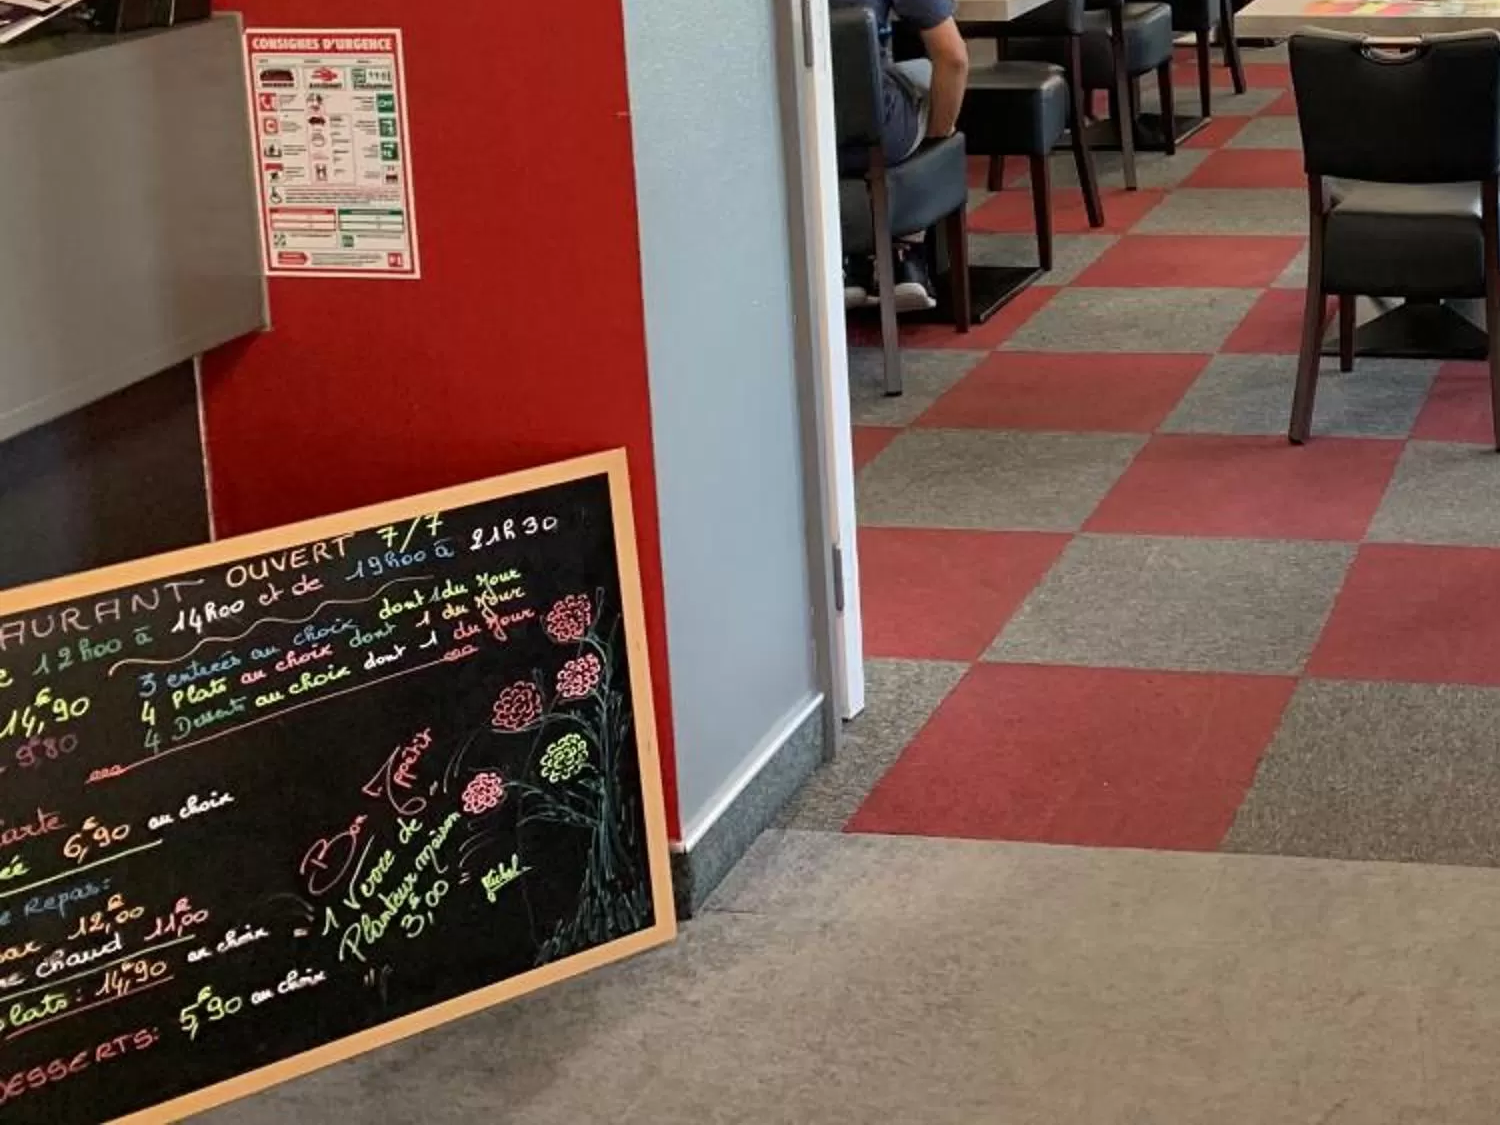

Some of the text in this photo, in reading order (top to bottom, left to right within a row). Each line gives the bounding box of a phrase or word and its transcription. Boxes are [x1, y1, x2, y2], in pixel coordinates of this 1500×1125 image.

[251, 37, 394, 51] CONSIGNES D'URGENCE
[225, 534, 356, 588] OUVERT
[376, 511, 444, 554] 7/7
[32, 637, 122, 676] 12h00
[171, 599, 245, 635] 14h00
[258, 583, 284, 606] et
[291, 573, 324, 596] de
[344, 550, 428, 582] 19h00
[468, 515, 559, 551] 21h30
[250, 645, 281, 661] au
[292, 617, 358, 647] choix
[377, 588, 426, 621] dont
[441, 579, 469, 598] du
[140, 699, 156, 726] 4
[239, 669, 268, 685] au
[274, 643, 334, 673] choix
[349, 622, 398, 649] dont
[441, 603, 470, 621] du
[254, 690, 285, 708] au
[288, 663, 352, 695] choix
[363, 644, 407, 671] dont
[453, 621, 482, 641] du
[0, 807, 66, 848] arte
[148, 815, 174, 830] au
[179, 790, 235, 819] choix
[35, 931, 123, 978] chaud
[187, 946, 214, 963] au
[217, 923, 270, 953] choix
[251, 989, 275, 1005] au
[277, 968, 328, 994] choix
